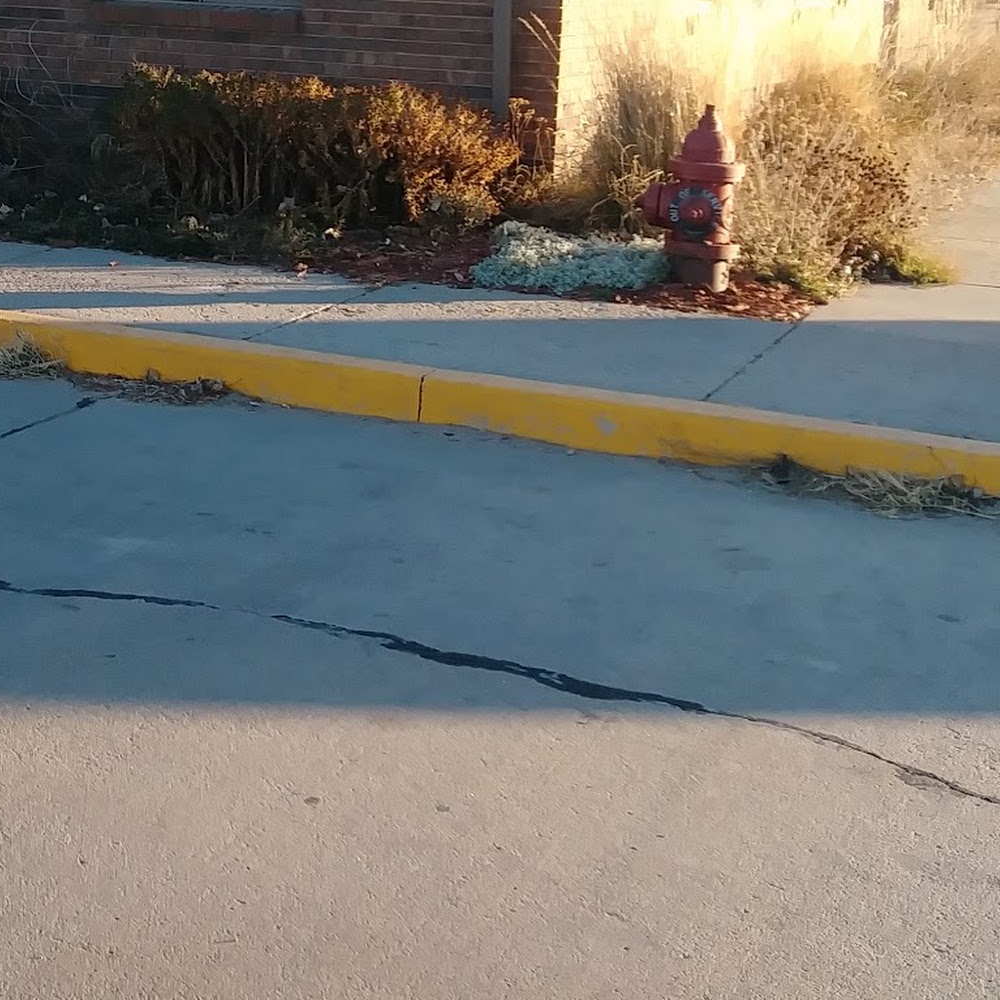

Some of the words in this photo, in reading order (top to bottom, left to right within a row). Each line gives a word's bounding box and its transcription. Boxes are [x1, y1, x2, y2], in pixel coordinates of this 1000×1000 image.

[669, 203, 680, 222] OUT
[679, 187, 691, 199] OF
[702, 188, 722, 222] SERVI
